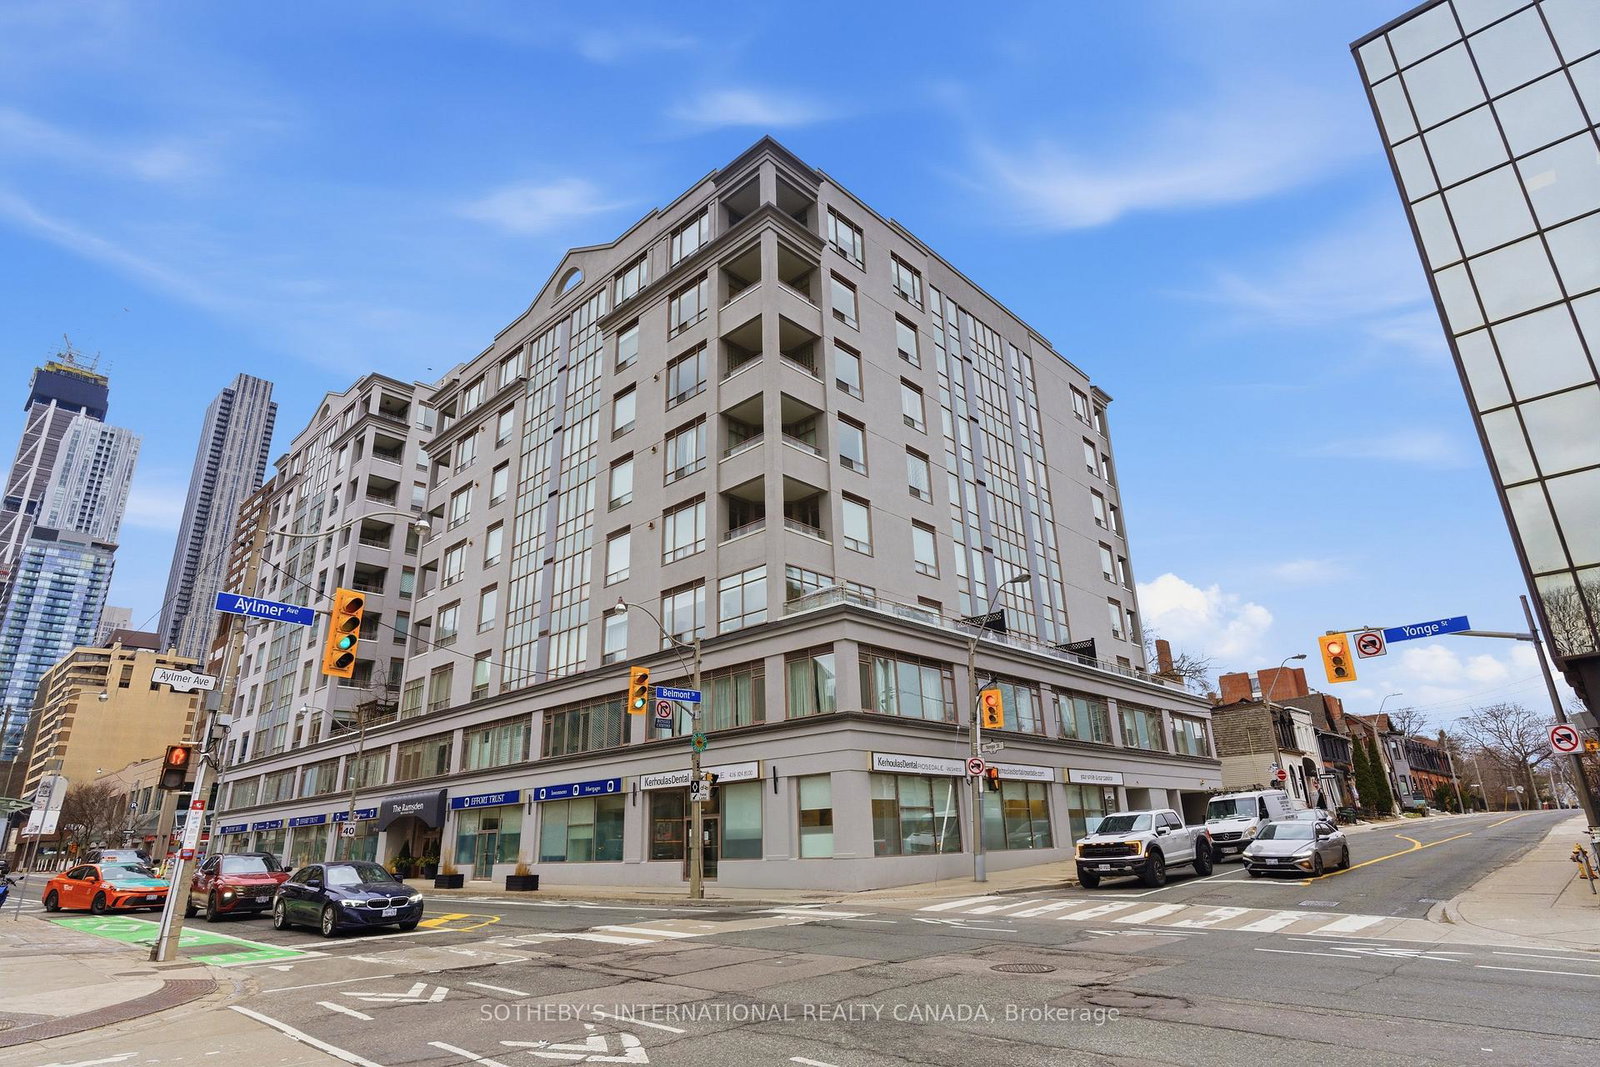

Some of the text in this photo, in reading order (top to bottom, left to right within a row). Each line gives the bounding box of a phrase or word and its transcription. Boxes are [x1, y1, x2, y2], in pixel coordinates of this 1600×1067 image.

[234, 597, 299, 616] Aylmer Ave
[1402, 623, 1439, 637] Yonge
[159, 671, 210, 686] Aylmer Ave
[662, 688, 690, 699] Belmont
[644, 773, 690, 787] KerhoulasDental
[470, 794, 505, 805] EFFORT TRUST
[392, 804, 401, 813] The
[401, 802, 424, 811] Ramsden
[343, 827, 355, 835] 40
